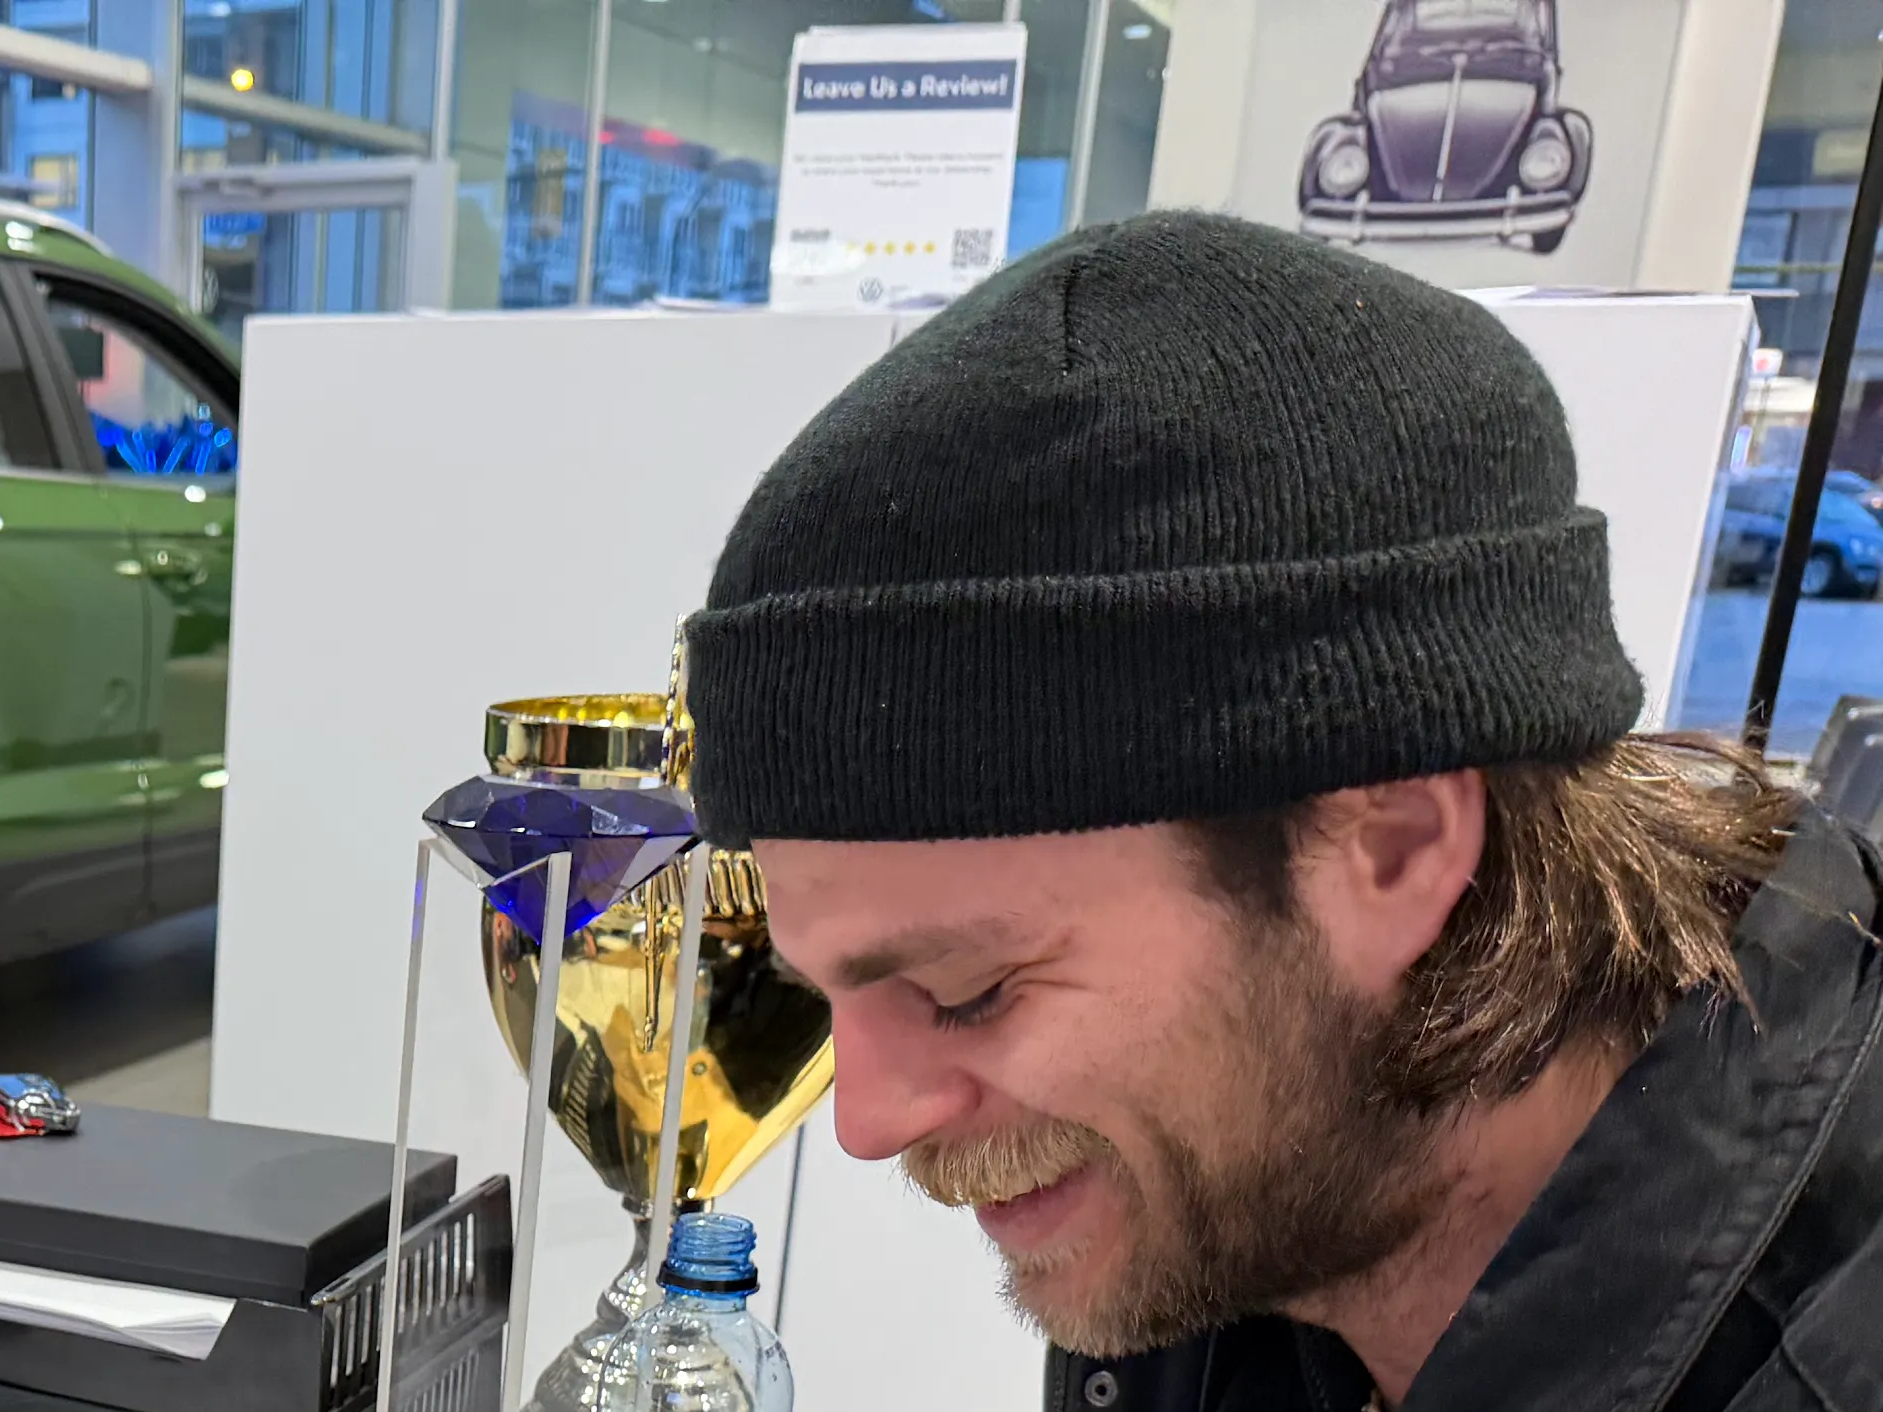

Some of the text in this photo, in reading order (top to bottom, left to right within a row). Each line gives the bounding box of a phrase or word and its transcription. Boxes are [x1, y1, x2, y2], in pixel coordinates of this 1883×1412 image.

[803, 73, 1008, 99] Leave Us a Review!
